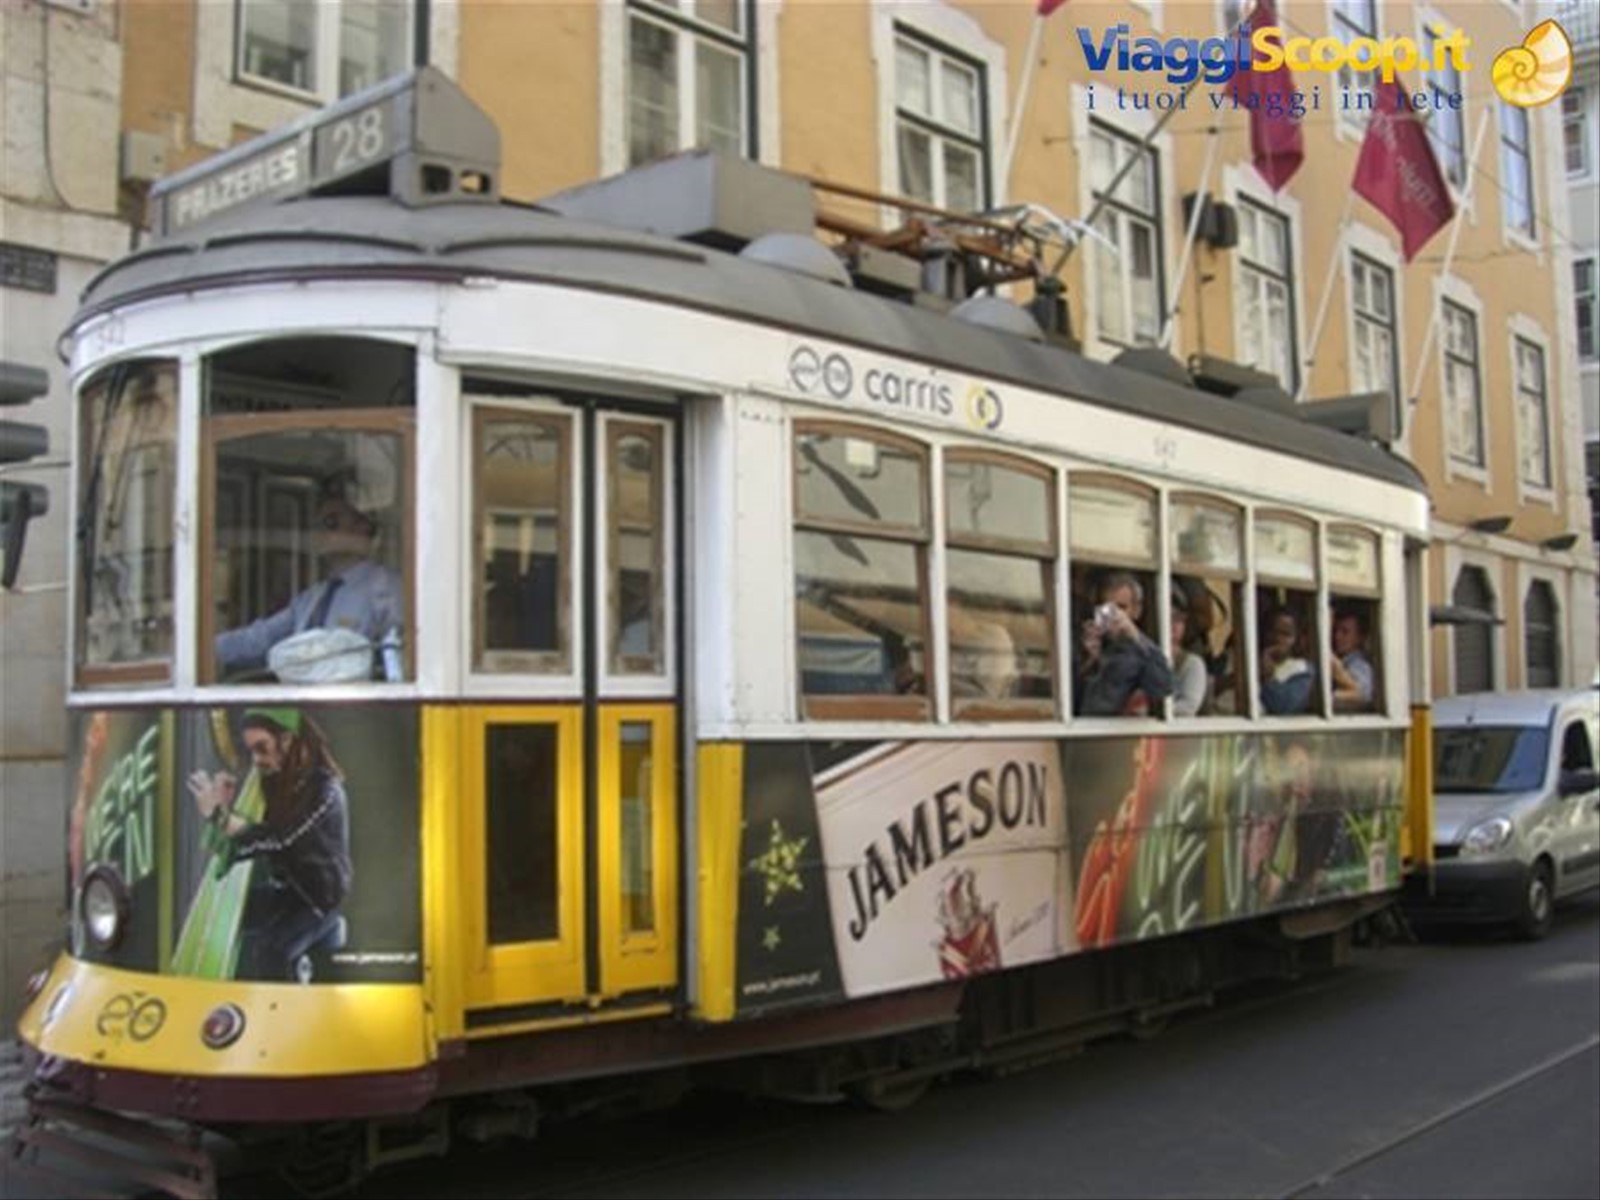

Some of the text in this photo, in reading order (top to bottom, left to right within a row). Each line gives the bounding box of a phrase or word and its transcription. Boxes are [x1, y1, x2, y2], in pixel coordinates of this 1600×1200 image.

[176, 106, 385, 227] PRAZERES 28
[863, 368, 954, 416] carris
[847, 760, 1048, 942] JAMESON
